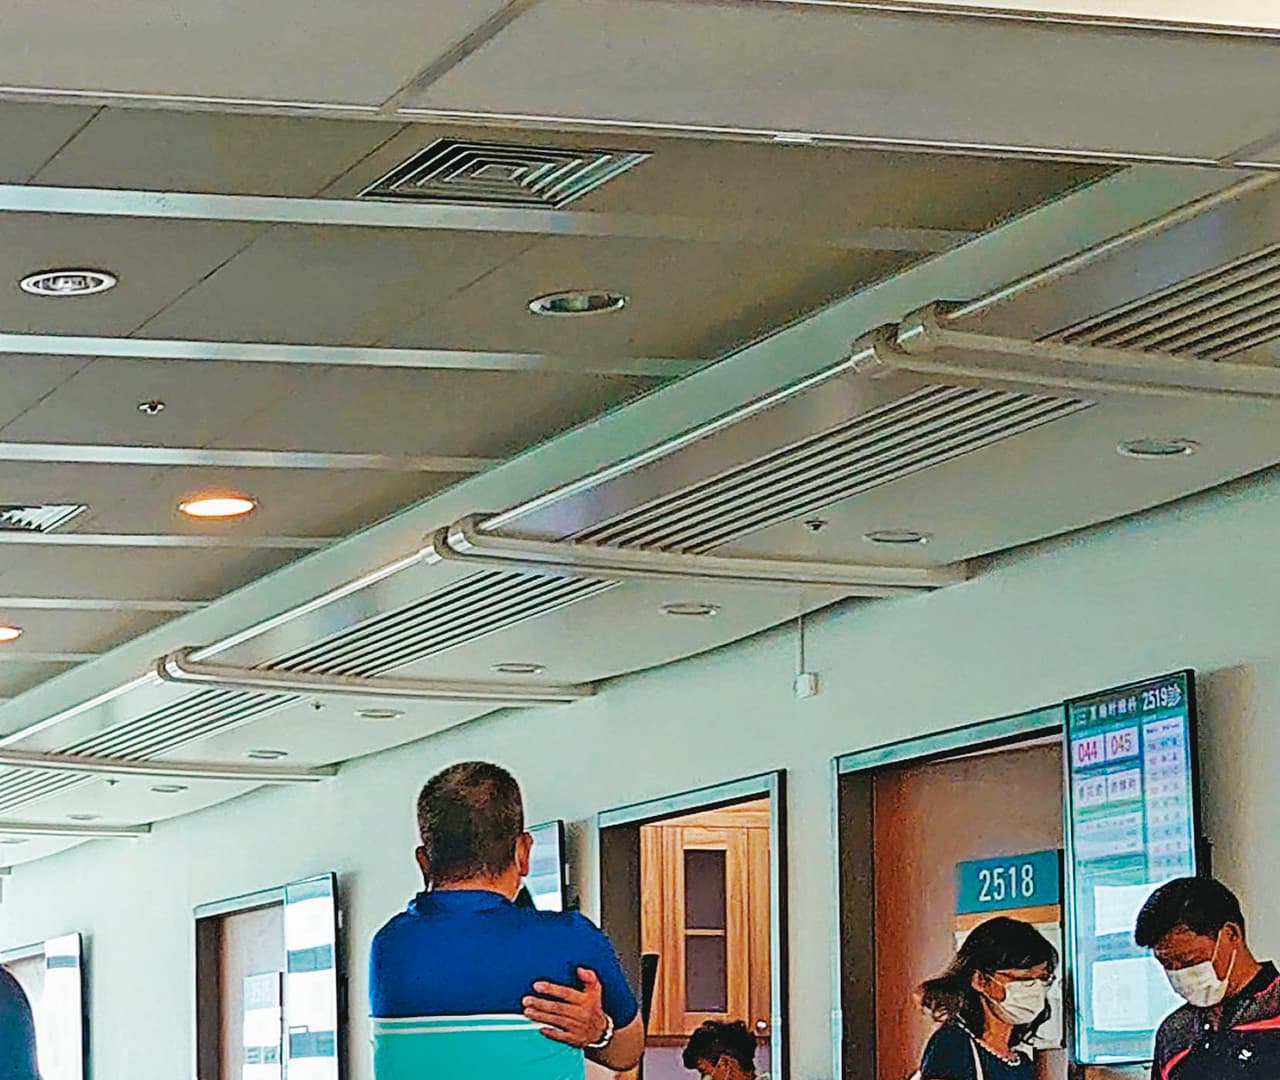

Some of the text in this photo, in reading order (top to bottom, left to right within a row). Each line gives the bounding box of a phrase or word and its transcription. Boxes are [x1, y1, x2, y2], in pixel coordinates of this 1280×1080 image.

[1078, 740, 1098, 763] 044
[1111, 733, 1132, 755] 045
[979, 864, 1034, 902] 2518
